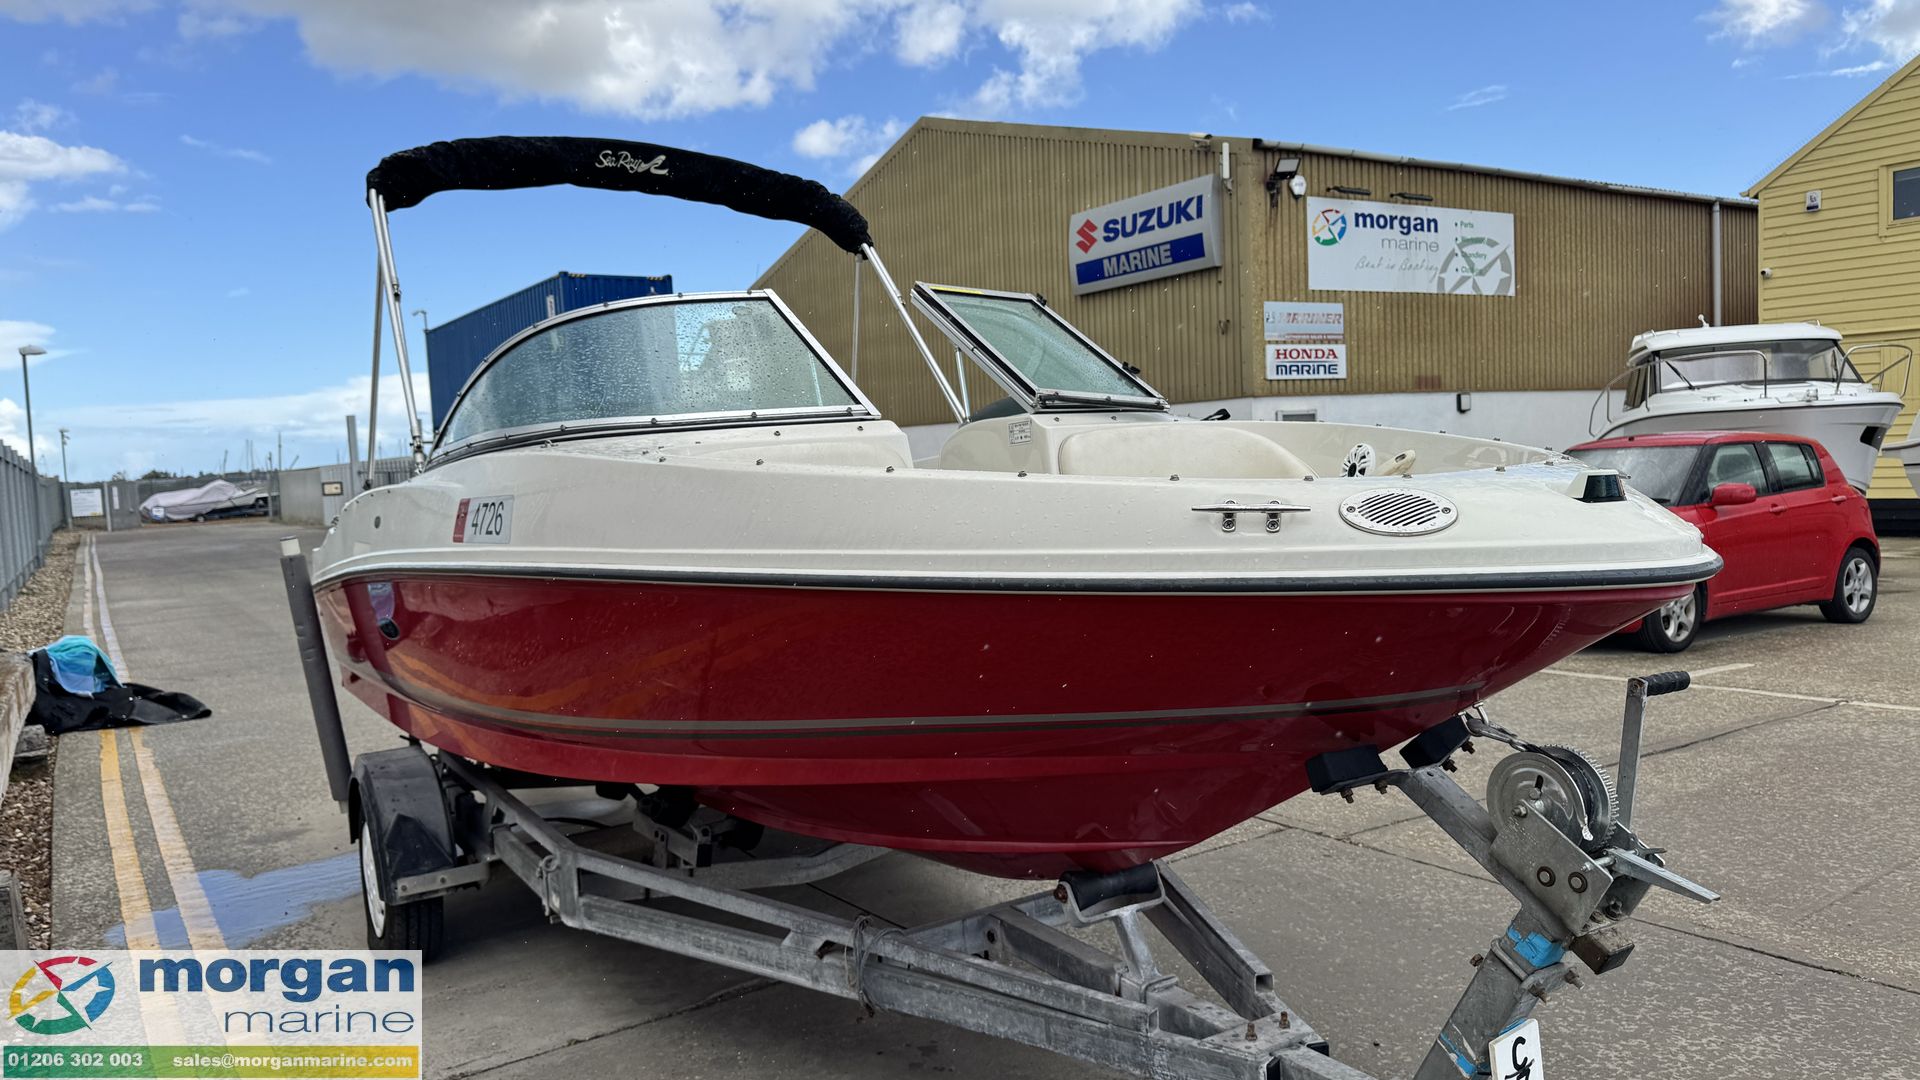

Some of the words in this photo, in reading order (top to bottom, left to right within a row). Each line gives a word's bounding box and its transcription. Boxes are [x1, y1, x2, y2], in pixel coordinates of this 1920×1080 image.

[595, 149, 617, 168] Sea
[617, 151, 641, 173] Ray
[1103, 194, 1203, 243] SUZUKI
[1354, 212, 1438, 235] morgan
[1381, 237, 1439, 253] marine
[1103, 243, 1173, 278] MARINE
[1275, 348, 1338, 360] HONDA
[1276, 364, 1338, 376] MARINE
[471, 501, 505, 536] 4726
